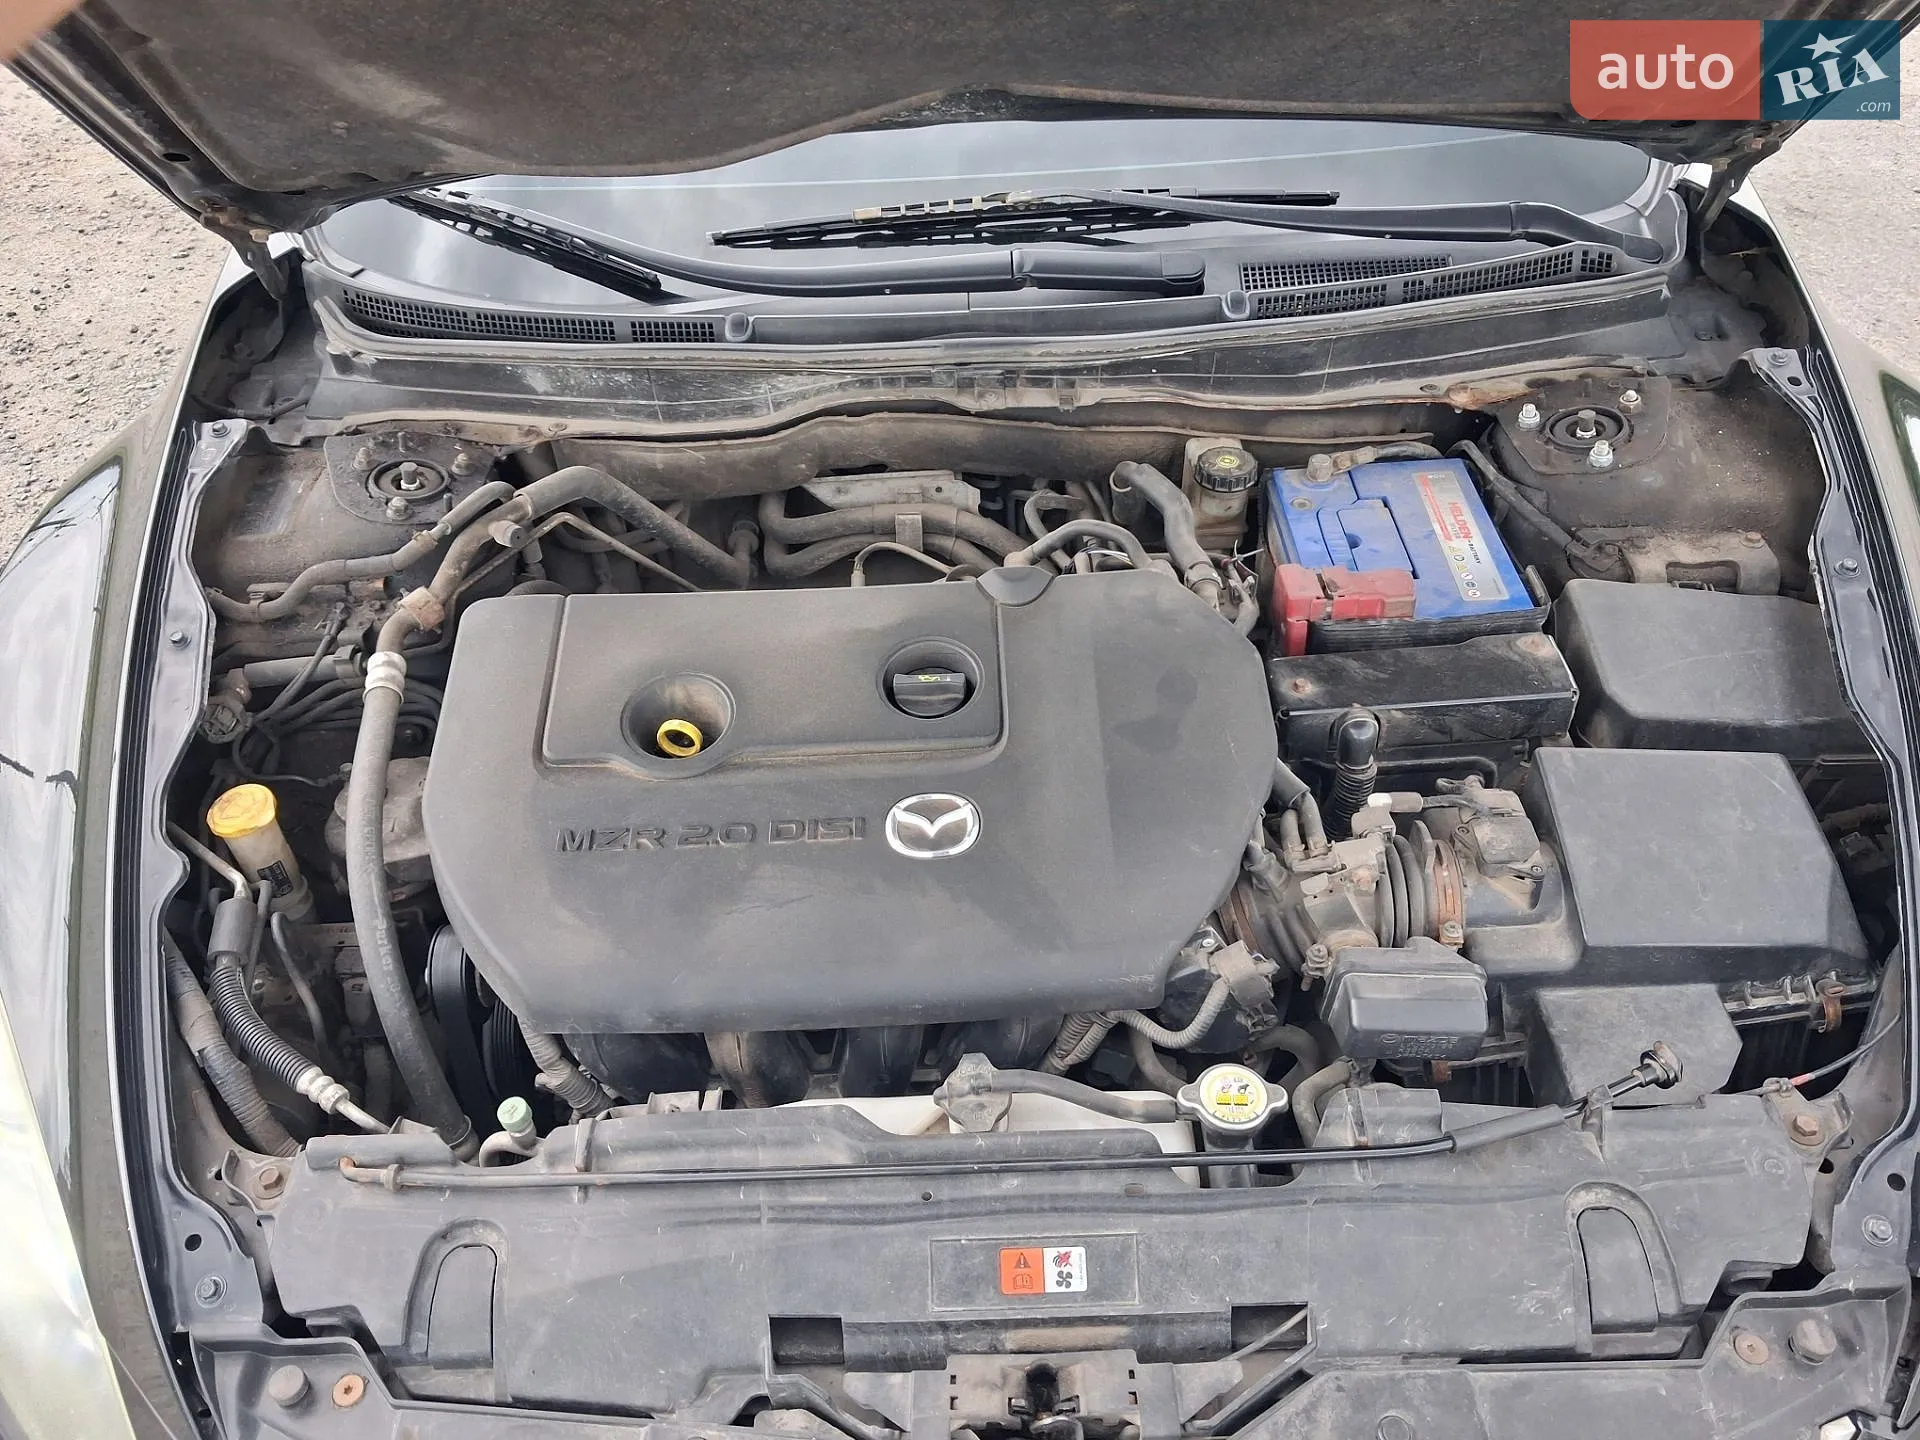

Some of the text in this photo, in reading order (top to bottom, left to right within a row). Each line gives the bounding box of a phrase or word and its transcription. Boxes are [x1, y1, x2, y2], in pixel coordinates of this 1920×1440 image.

[1448, 502, 1473, 541] HELDEN
[555, 816, 867, 852] MZR 2.0 DISI
